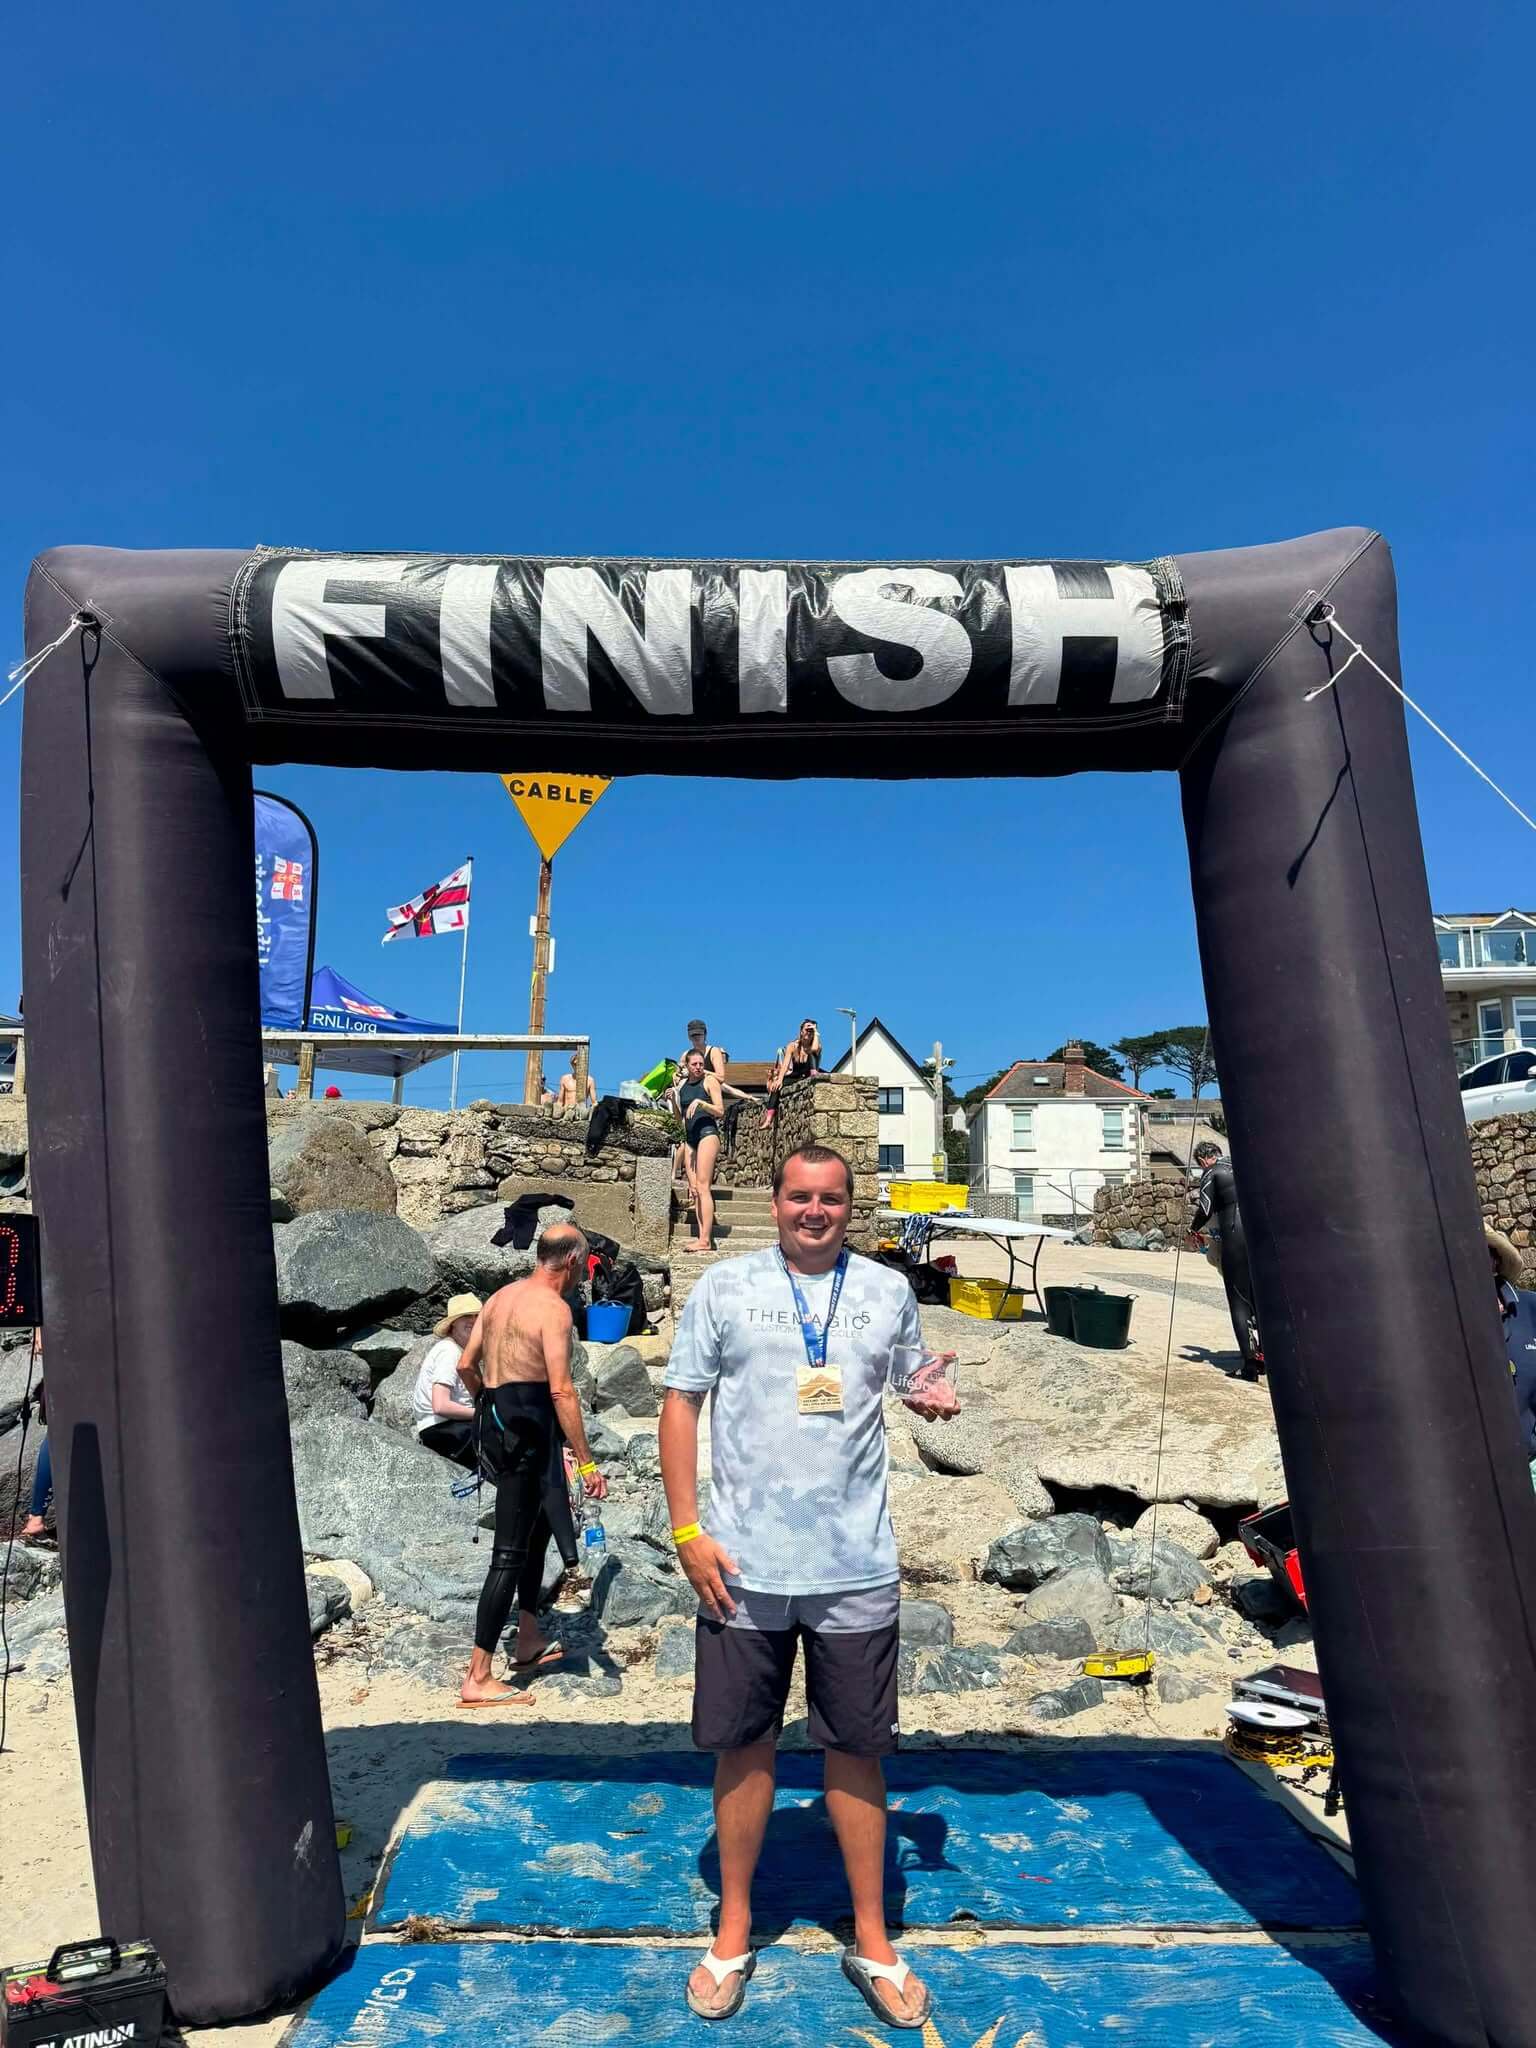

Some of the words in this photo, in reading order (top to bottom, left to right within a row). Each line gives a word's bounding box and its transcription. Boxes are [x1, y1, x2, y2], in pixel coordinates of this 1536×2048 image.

[272, 560, 1167, 714] FINISH
[509, 779, 593, 805] CABLE
[313, 1012, 377, 1034] RNLI.org
[35, 2023, 135, 2048] ATINUM
